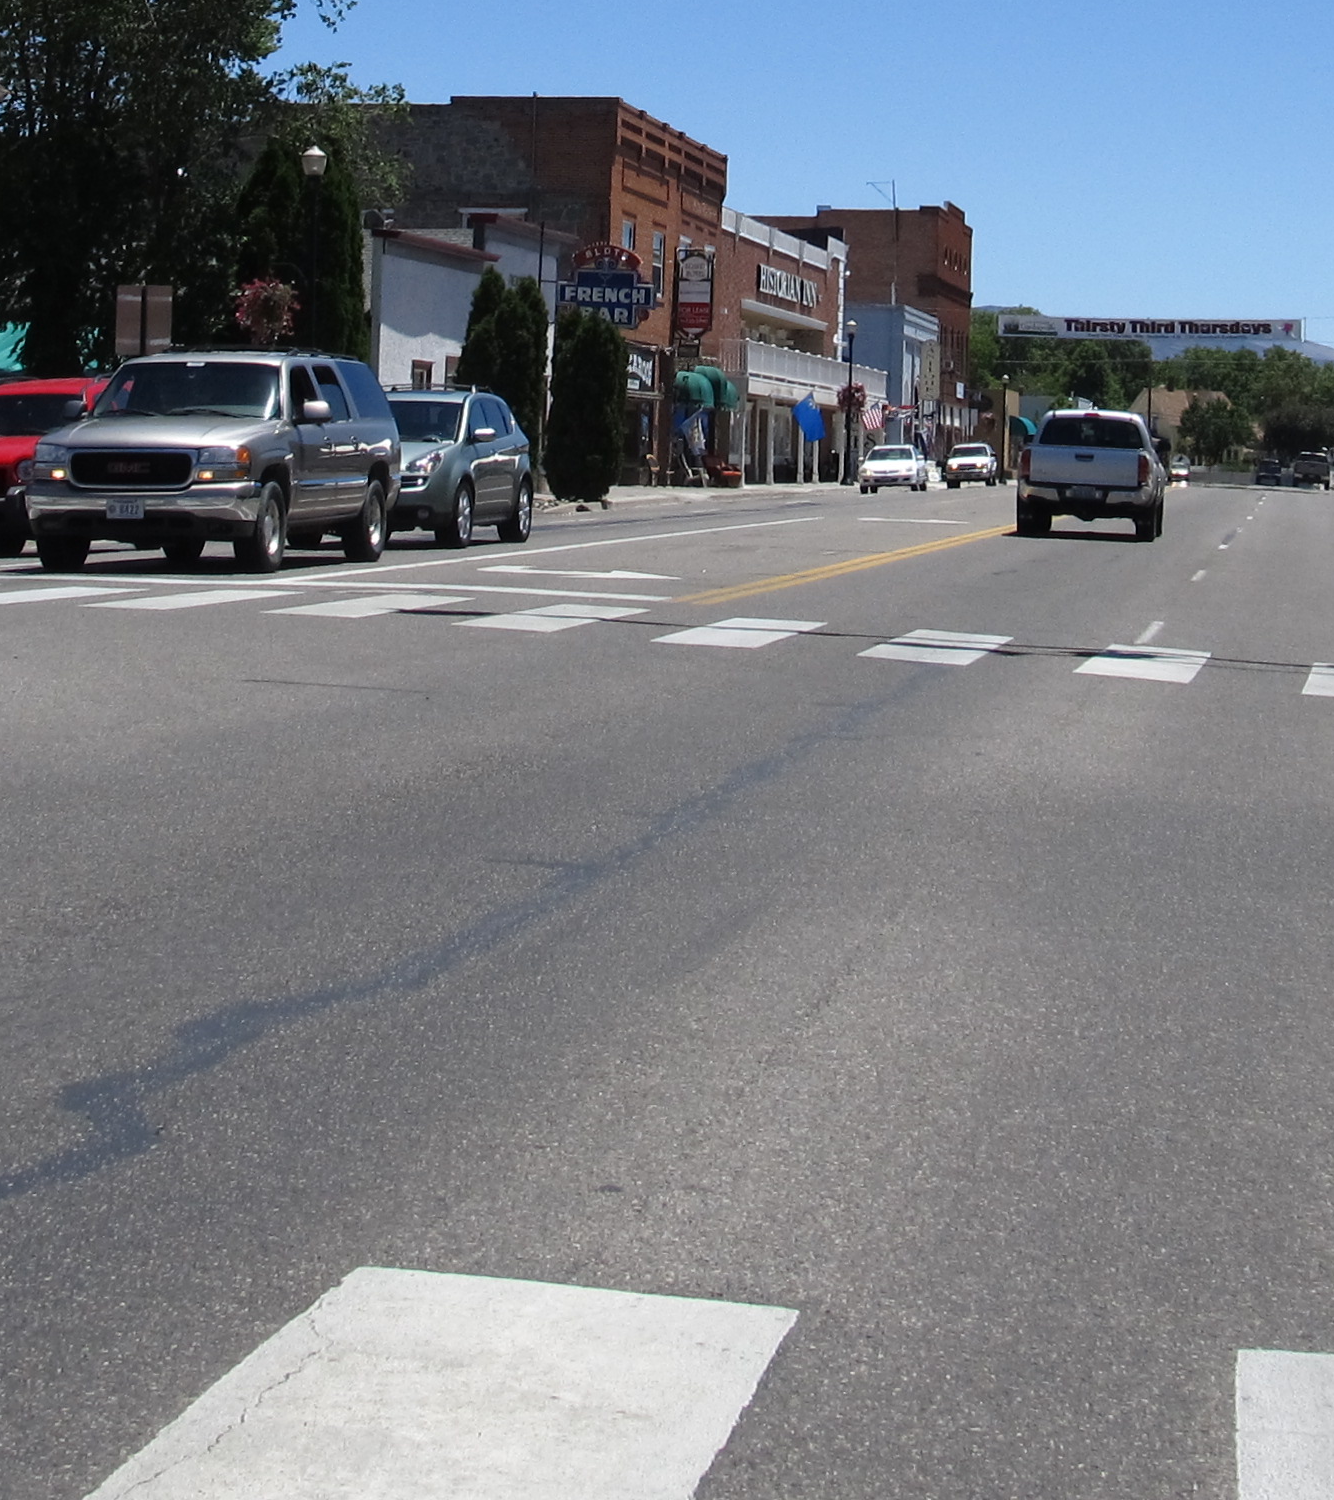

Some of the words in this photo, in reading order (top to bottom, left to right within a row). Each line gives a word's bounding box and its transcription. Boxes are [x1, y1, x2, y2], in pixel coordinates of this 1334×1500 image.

[564, 286, 646, 304] FRENCH
[579, 306, 629, 324] BAR
[1064, 318, 1126, 335] Thirsty
[1129, 320, 1175, 334] Third
[1179, 320, 1273, 335] Thursdays
[107, 461, 151, 474] GMC
